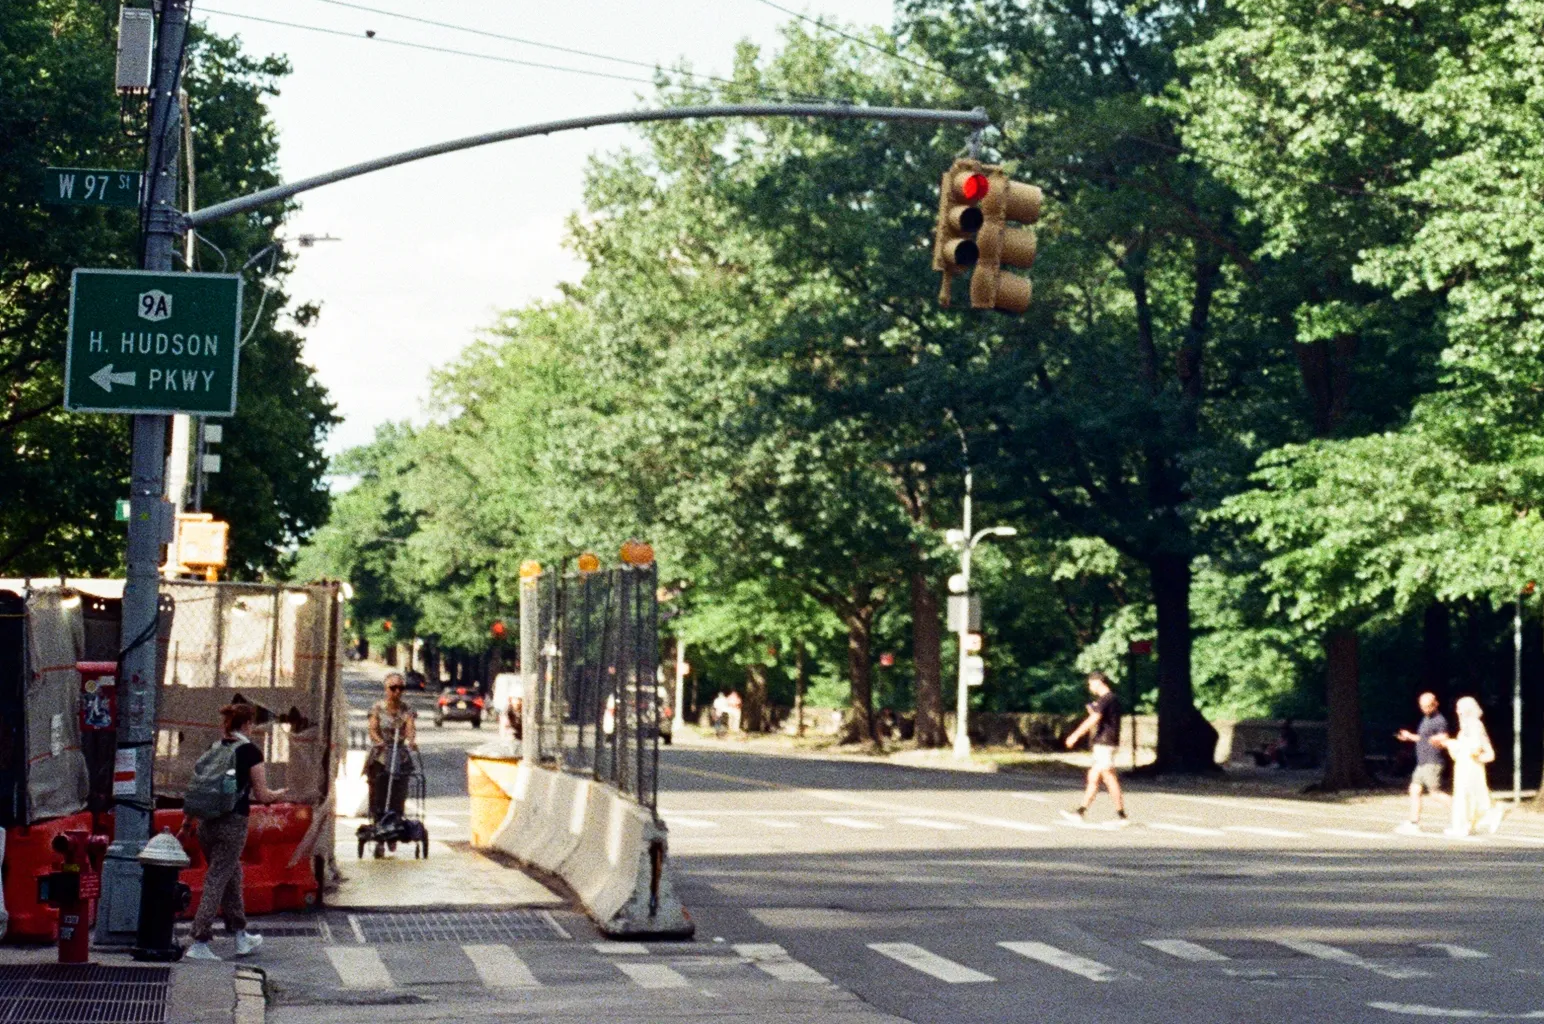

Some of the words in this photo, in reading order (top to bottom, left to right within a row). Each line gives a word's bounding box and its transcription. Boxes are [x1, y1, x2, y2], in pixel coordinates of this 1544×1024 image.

[59, 173, 76, 199] W
[84, 174, 109, 200] 97
[118, 174, 131, 190] St
[142, 295, 168, 317] 9A
[89, 331, 109, 353] H.
[121, 332, 218, 356] HUDSON
[149, 369, 215, 392] PKWY
